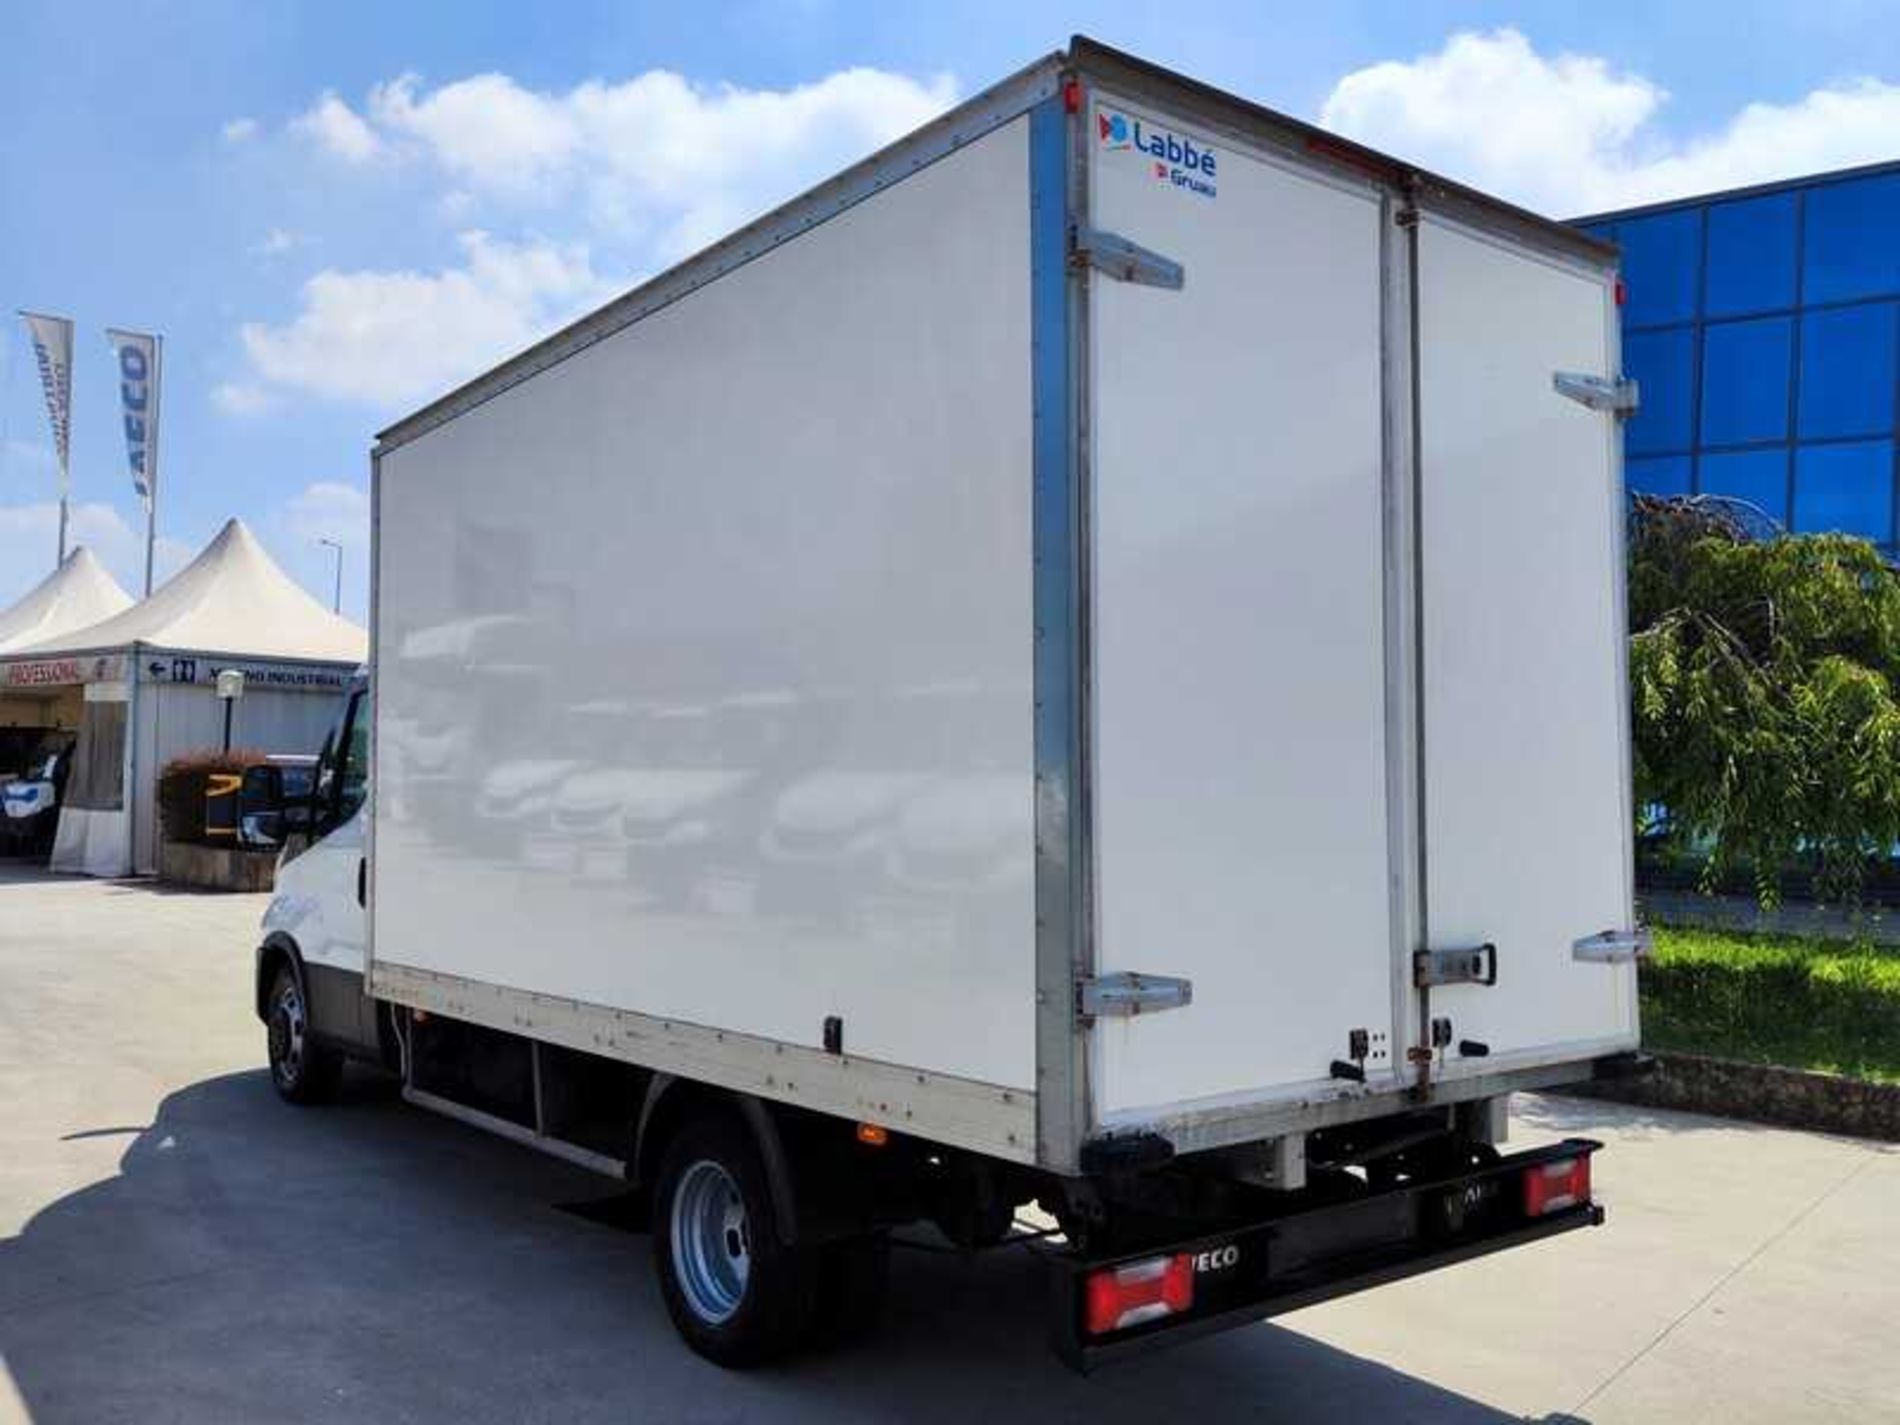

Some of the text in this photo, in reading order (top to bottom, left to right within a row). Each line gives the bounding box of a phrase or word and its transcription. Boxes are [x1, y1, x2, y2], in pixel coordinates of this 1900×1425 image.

[1134, 121, 1217, 177] Labbé
[8, 662, 80, 685] PROFESSIONAL
[268, 671, 343, 687] INDUSTRIAL
